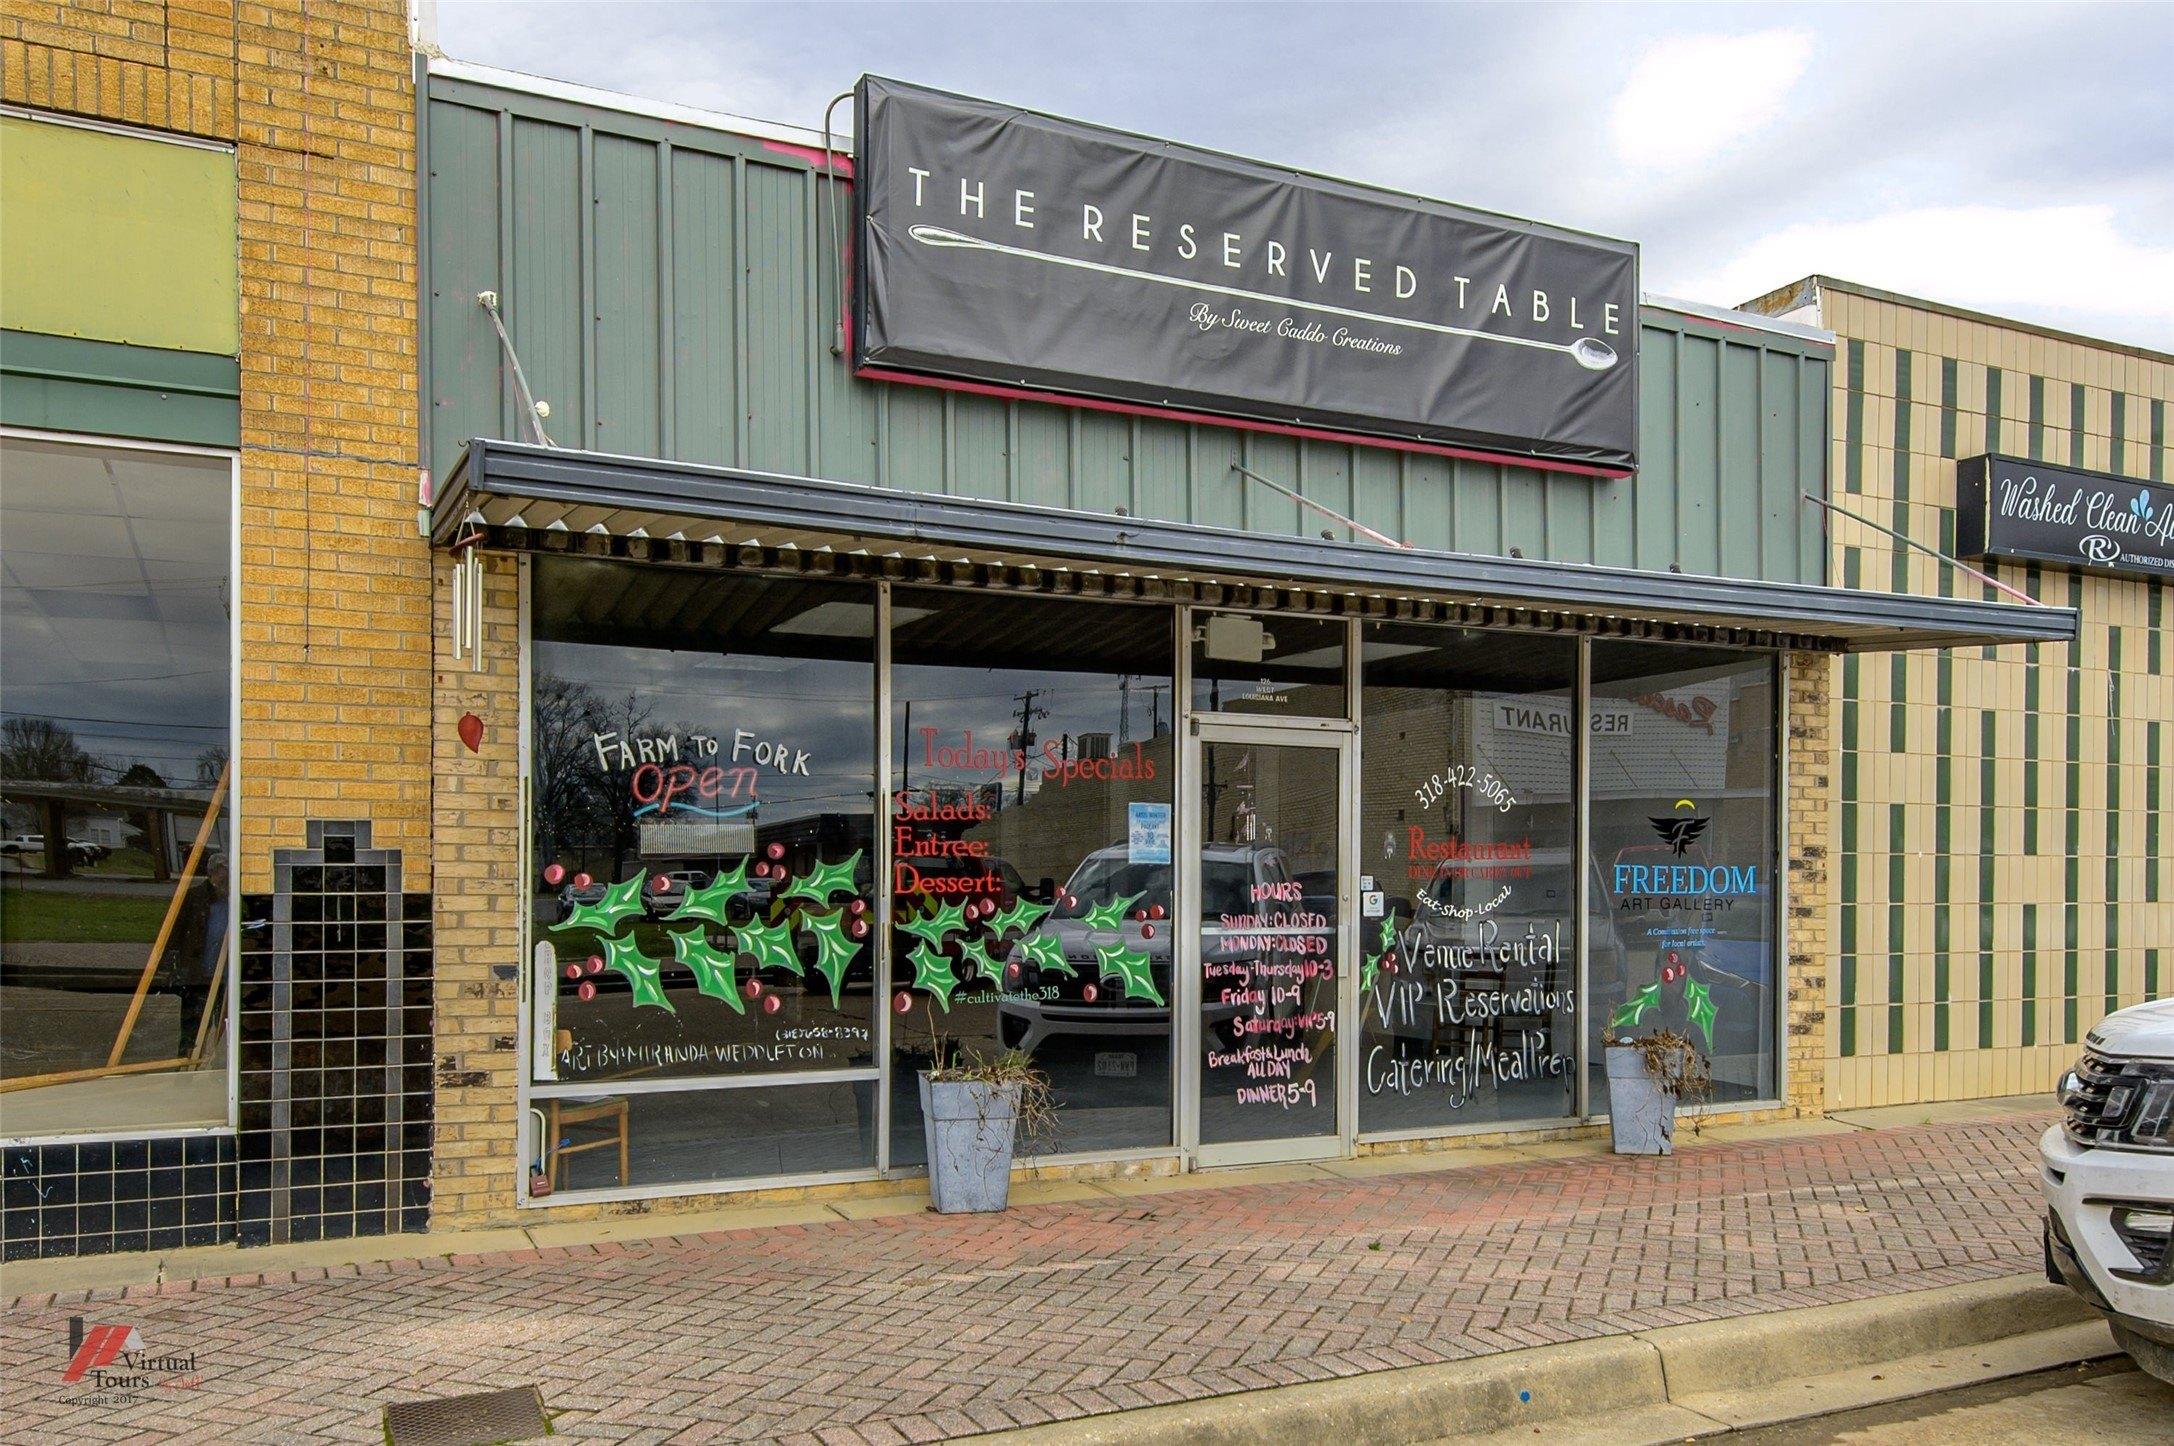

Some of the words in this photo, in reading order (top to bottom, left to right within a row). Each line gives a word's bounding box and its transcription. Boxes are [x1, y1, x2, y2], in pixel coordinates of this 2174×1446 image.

[908, 166, 1035, 229] THE
[1083, 204, 1417, 299] RESERVED
[1453, 275, 1620, 335] TABLE
[1189, 302, 1219, 331] By
[1221, 308, 1272, 334] Sweet
[1277, 317, 1328, 343] Caddo
[1332, 327, 1403, 356] Creations
[2000, 476, 2082, 525] Washed
[2086, 491, 2142, 534] Clean
[2120, 553, 2164, 567] AUTHORIZED
[594, 732, 679, 772] FARM
[691, 735, 718, 758] TO
[730, 728, 811, 776] FORK
[1042, 737, 1156, 788] Specials
[631, 762, 760, 814] Open
[1414, 764, 1517, 813] 318-422-5065
[893, 791, 992, 823] Salads:
[893, 826, 989, 857] Entree:
[1407, 824, 1533, 862] Restaurant
[893, 862, 1002, 896] Dessert:
[1250, 881, 1303, 904] HOURS
[1613, 864, 1757, 895] FREEDOM
[1416, 884, 1512, 921] Eat-Shop-Local
[1620, 897, 1655, 911] ART
[1659, 897, 1735, 911] GALLERY
[1398, 930, 1474, 974] Venue
[1479, 919, 1560, 973] Rental
[954, 985, 1060, 1004] #cultivatethe318
[1221, 987, 1266, 1015] Friday
[1271, 984, 1301, 1007] 10-9
[1374, 981, 1424, 1029] VIP
[1437, 976, 1575, 1025] Reservations
[560, 1044, 592, 1072] ART
[1236, 1083, 1289, 1110] DINNER
[1287, 1078, 1317, 1108] 5-9
